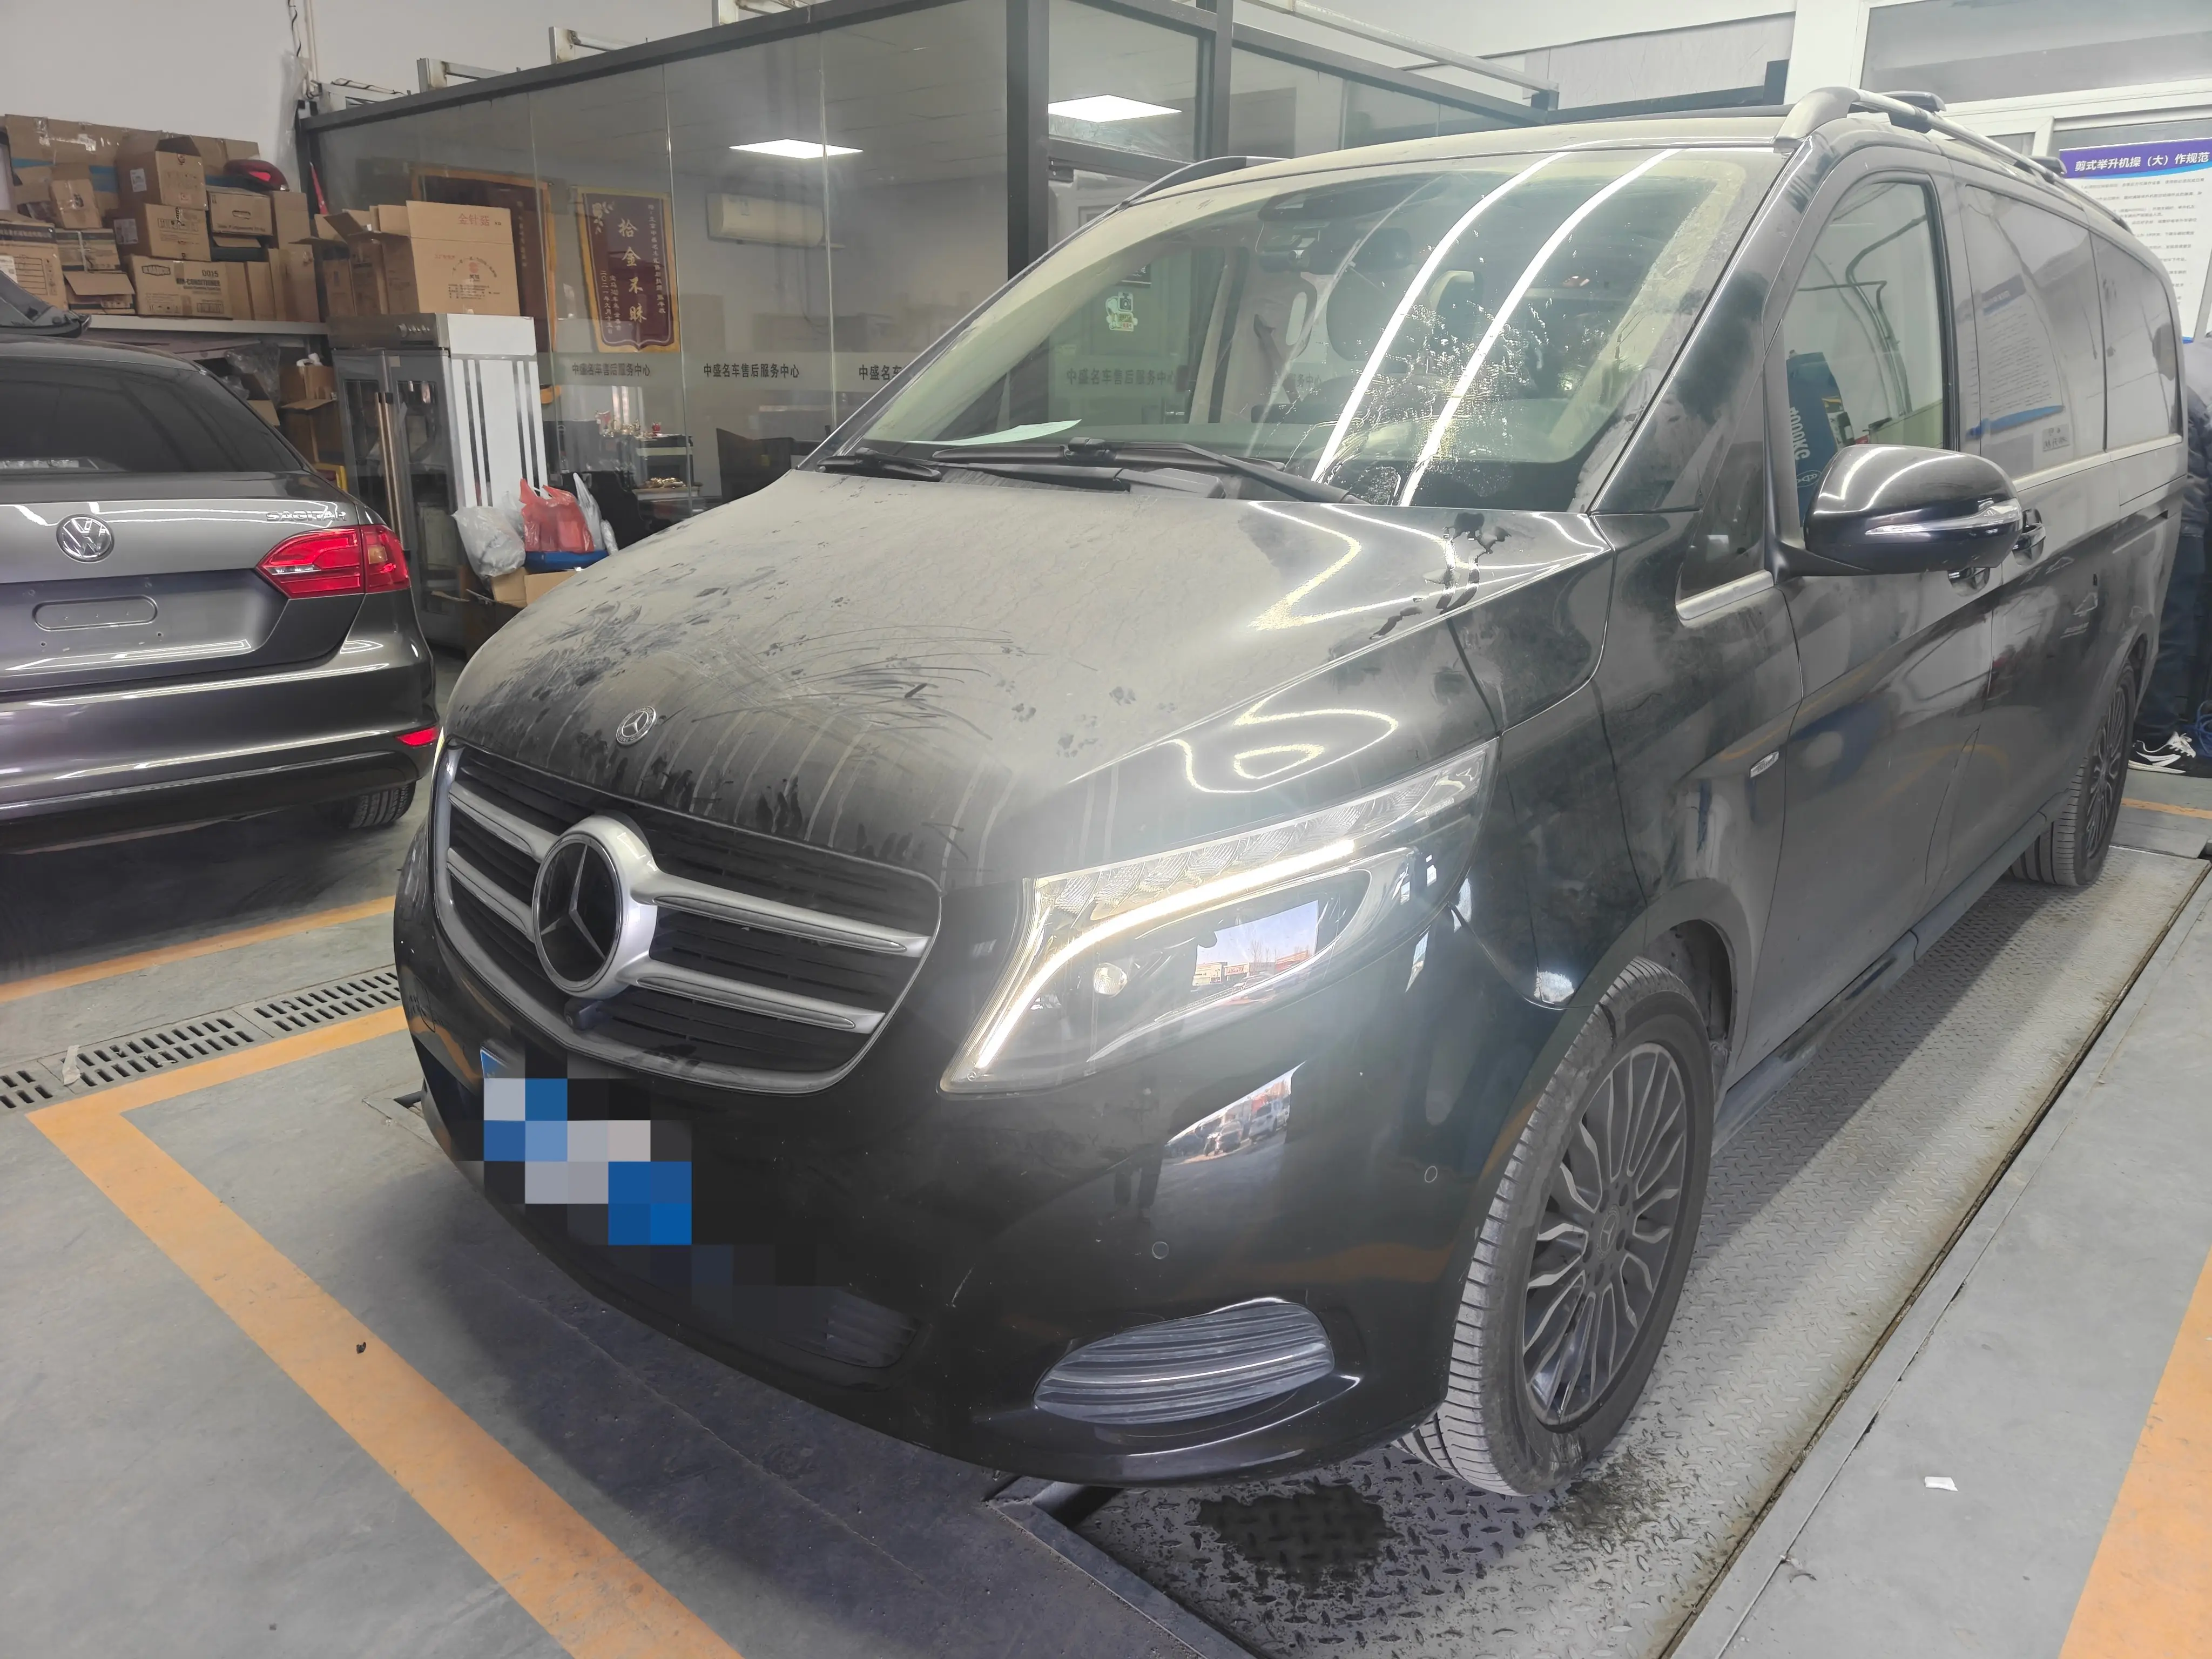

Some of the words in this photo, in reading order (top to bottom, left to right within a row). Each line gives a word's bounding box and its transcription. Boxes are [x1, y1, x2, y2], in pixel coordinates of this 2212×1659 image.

[2075, 151, 2210, 172] 剪式举升机操（大）作规范
[618, 218, 648, 323] 拾金不昧
[572, 362, 650, 376] 中盛名车售后服务中心
[704, 363, 799, 378] 中盛名车售后服务中心
[266, 510, 347, 521] SAGITAR
